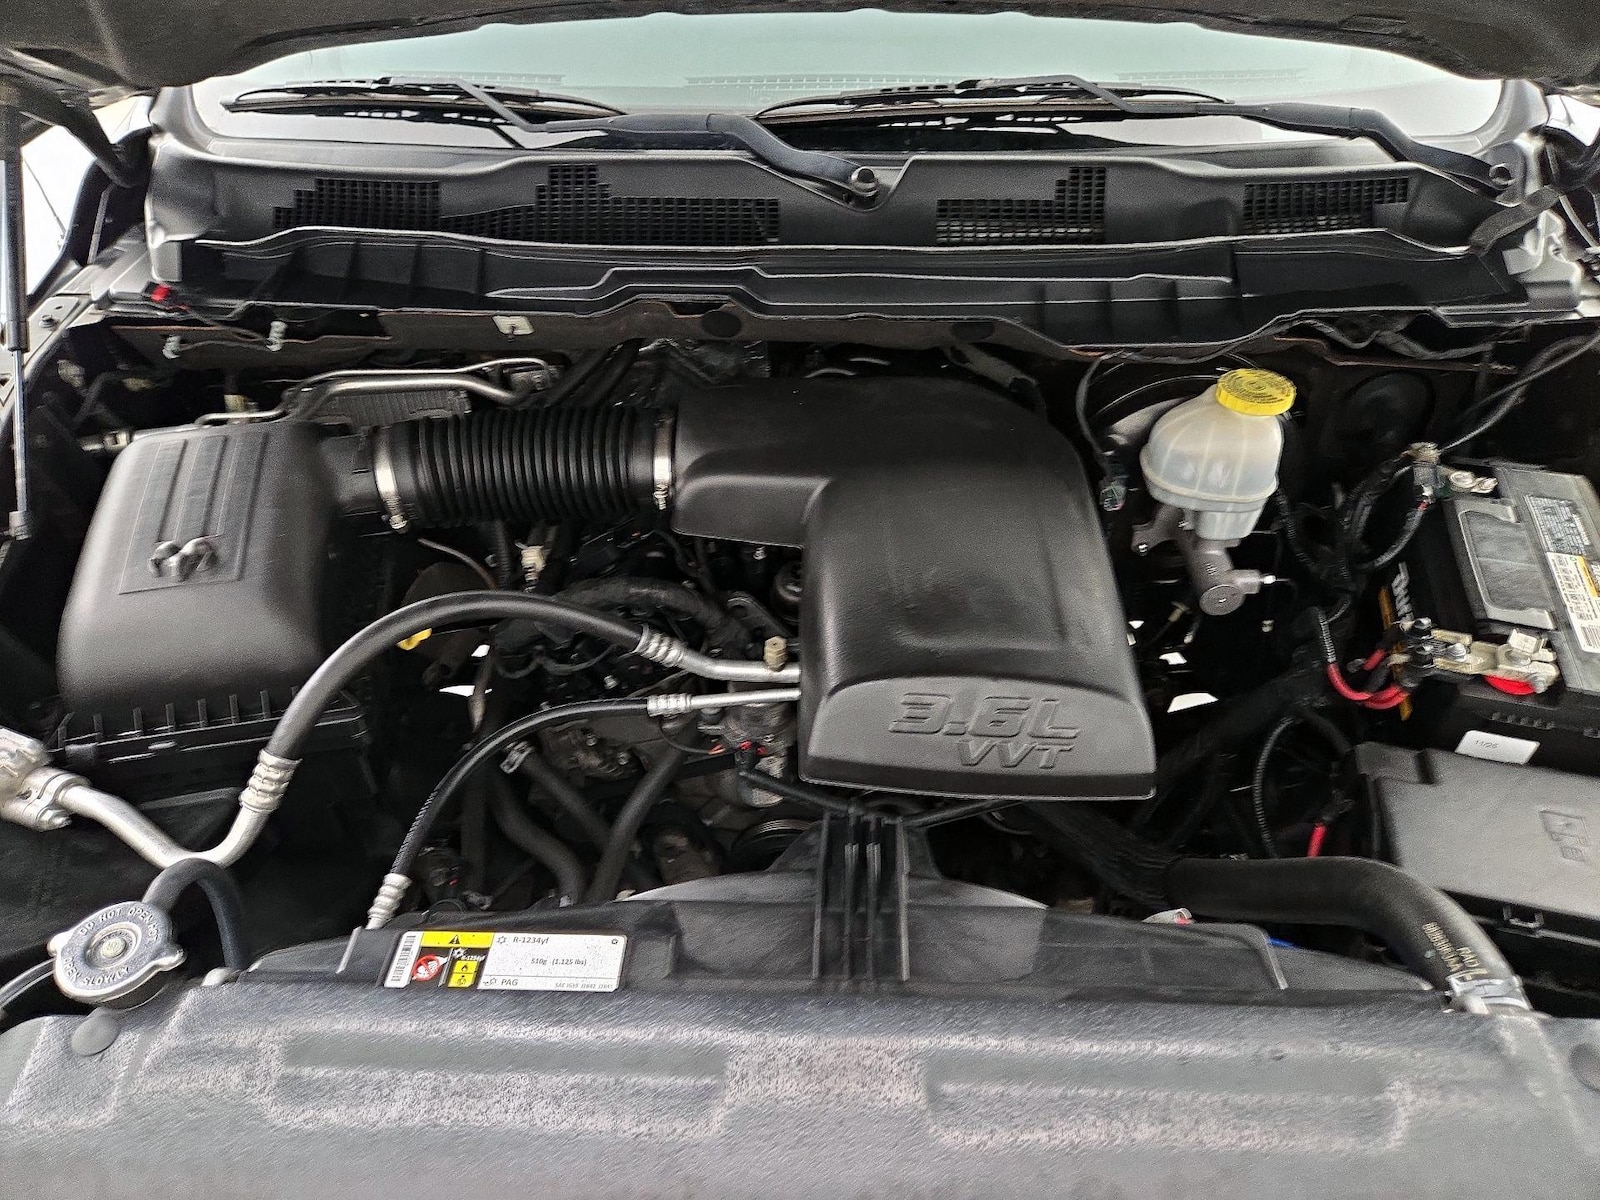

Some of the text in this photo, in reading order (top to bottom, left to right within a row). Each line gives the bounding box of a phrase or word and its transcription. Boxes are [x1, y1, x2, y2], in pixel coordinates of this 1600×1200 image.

[888, 692, 1081, 739] 3.6L
[956, 739, 1075, 769] VVT
[79, 921, 96, 935] DO
[99, 909, 122, 921] NOT
[128, 906, 153, 925] OPEN
[148, 922, 160, 941] HOT
[512, 936, 550, 945] R-1234yf
[63, 957, 129, 986] OPEN SLOWLY
[531, 958, 547, 966] 510g
[501, 978, 518, 986] PAG
